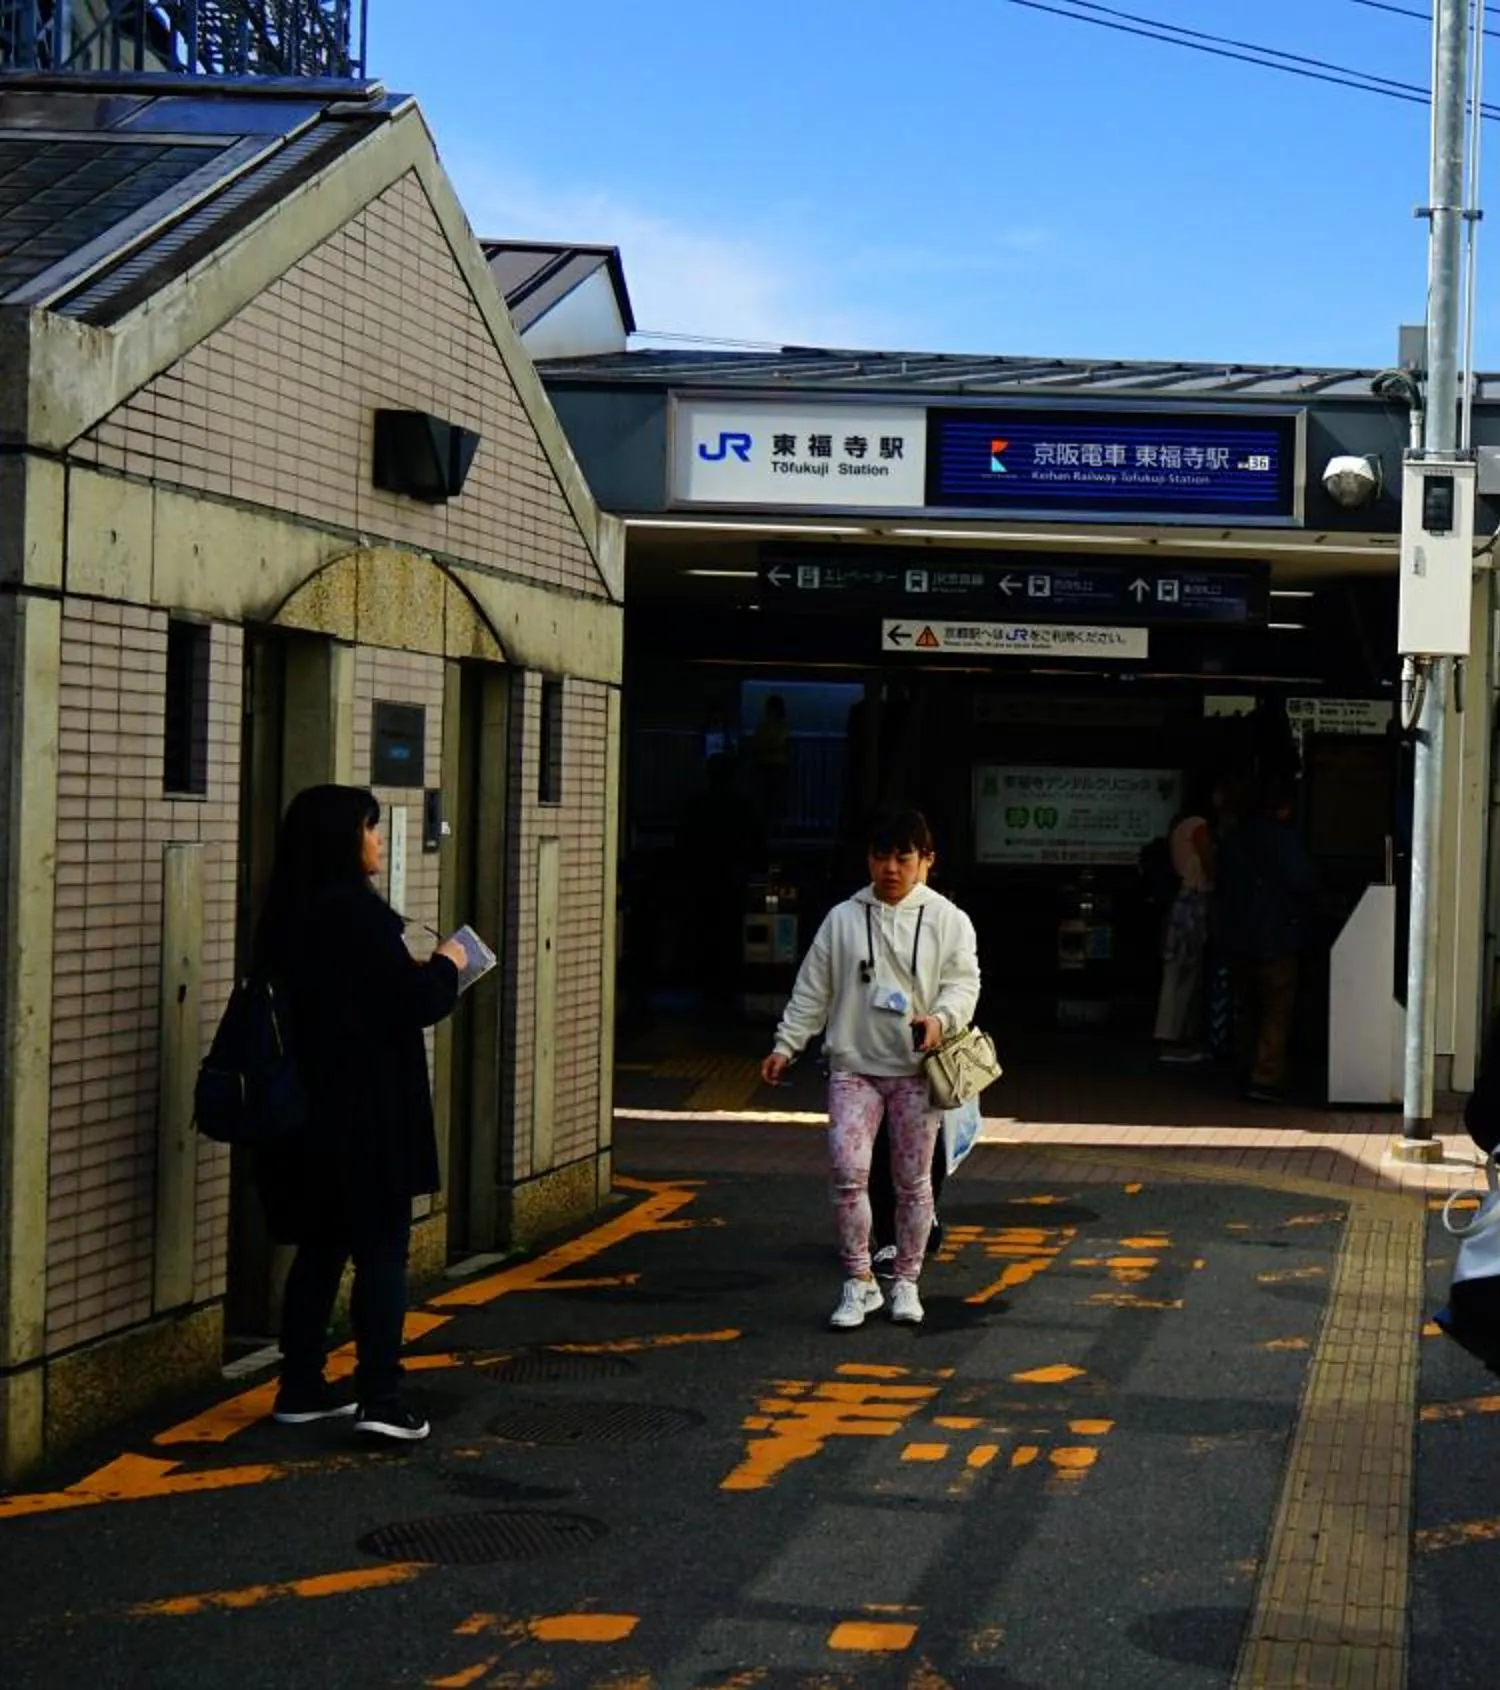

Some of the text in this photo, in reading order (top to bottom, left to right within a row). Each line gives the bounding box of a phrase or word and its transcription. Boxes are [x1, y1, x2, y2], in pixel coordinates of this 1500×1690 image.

[699, 432, 752, 462] JR
[772, 434, 904, 460] 東福寺駅
[1032, 443, 1230, 470] 京阪電車 東福寺駅
[838, 463, 889, 476] Station
[1251, 456, 1268, 470] 36
